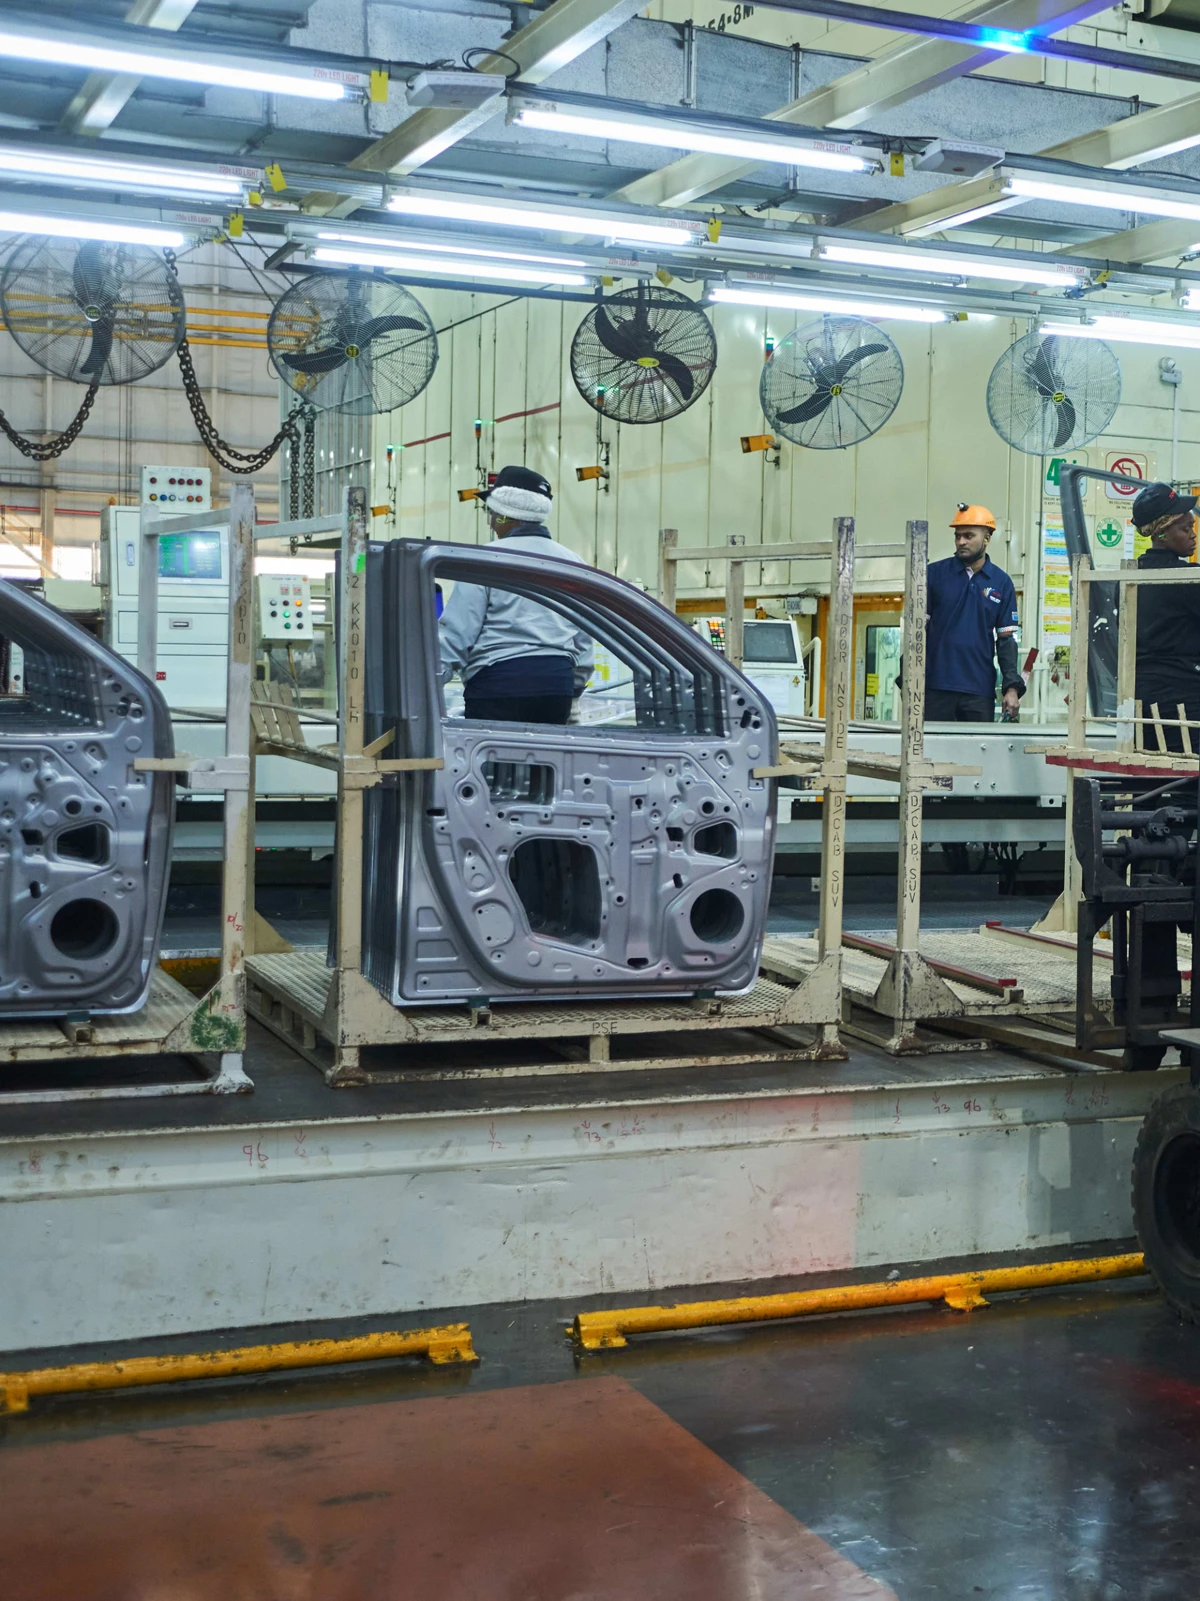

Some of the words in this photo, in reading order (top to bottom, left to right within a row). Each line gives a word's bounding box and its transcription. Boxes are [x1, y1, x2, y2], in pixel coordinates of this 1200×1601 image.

[836, 671, 846, 749] INSIDE
[911, 677, 922, 755] INSIDE
[831, 870, 840, 907] SUV
[909, 868, 917, 903] SUV
[242, 1142, 269, 1167] 96
